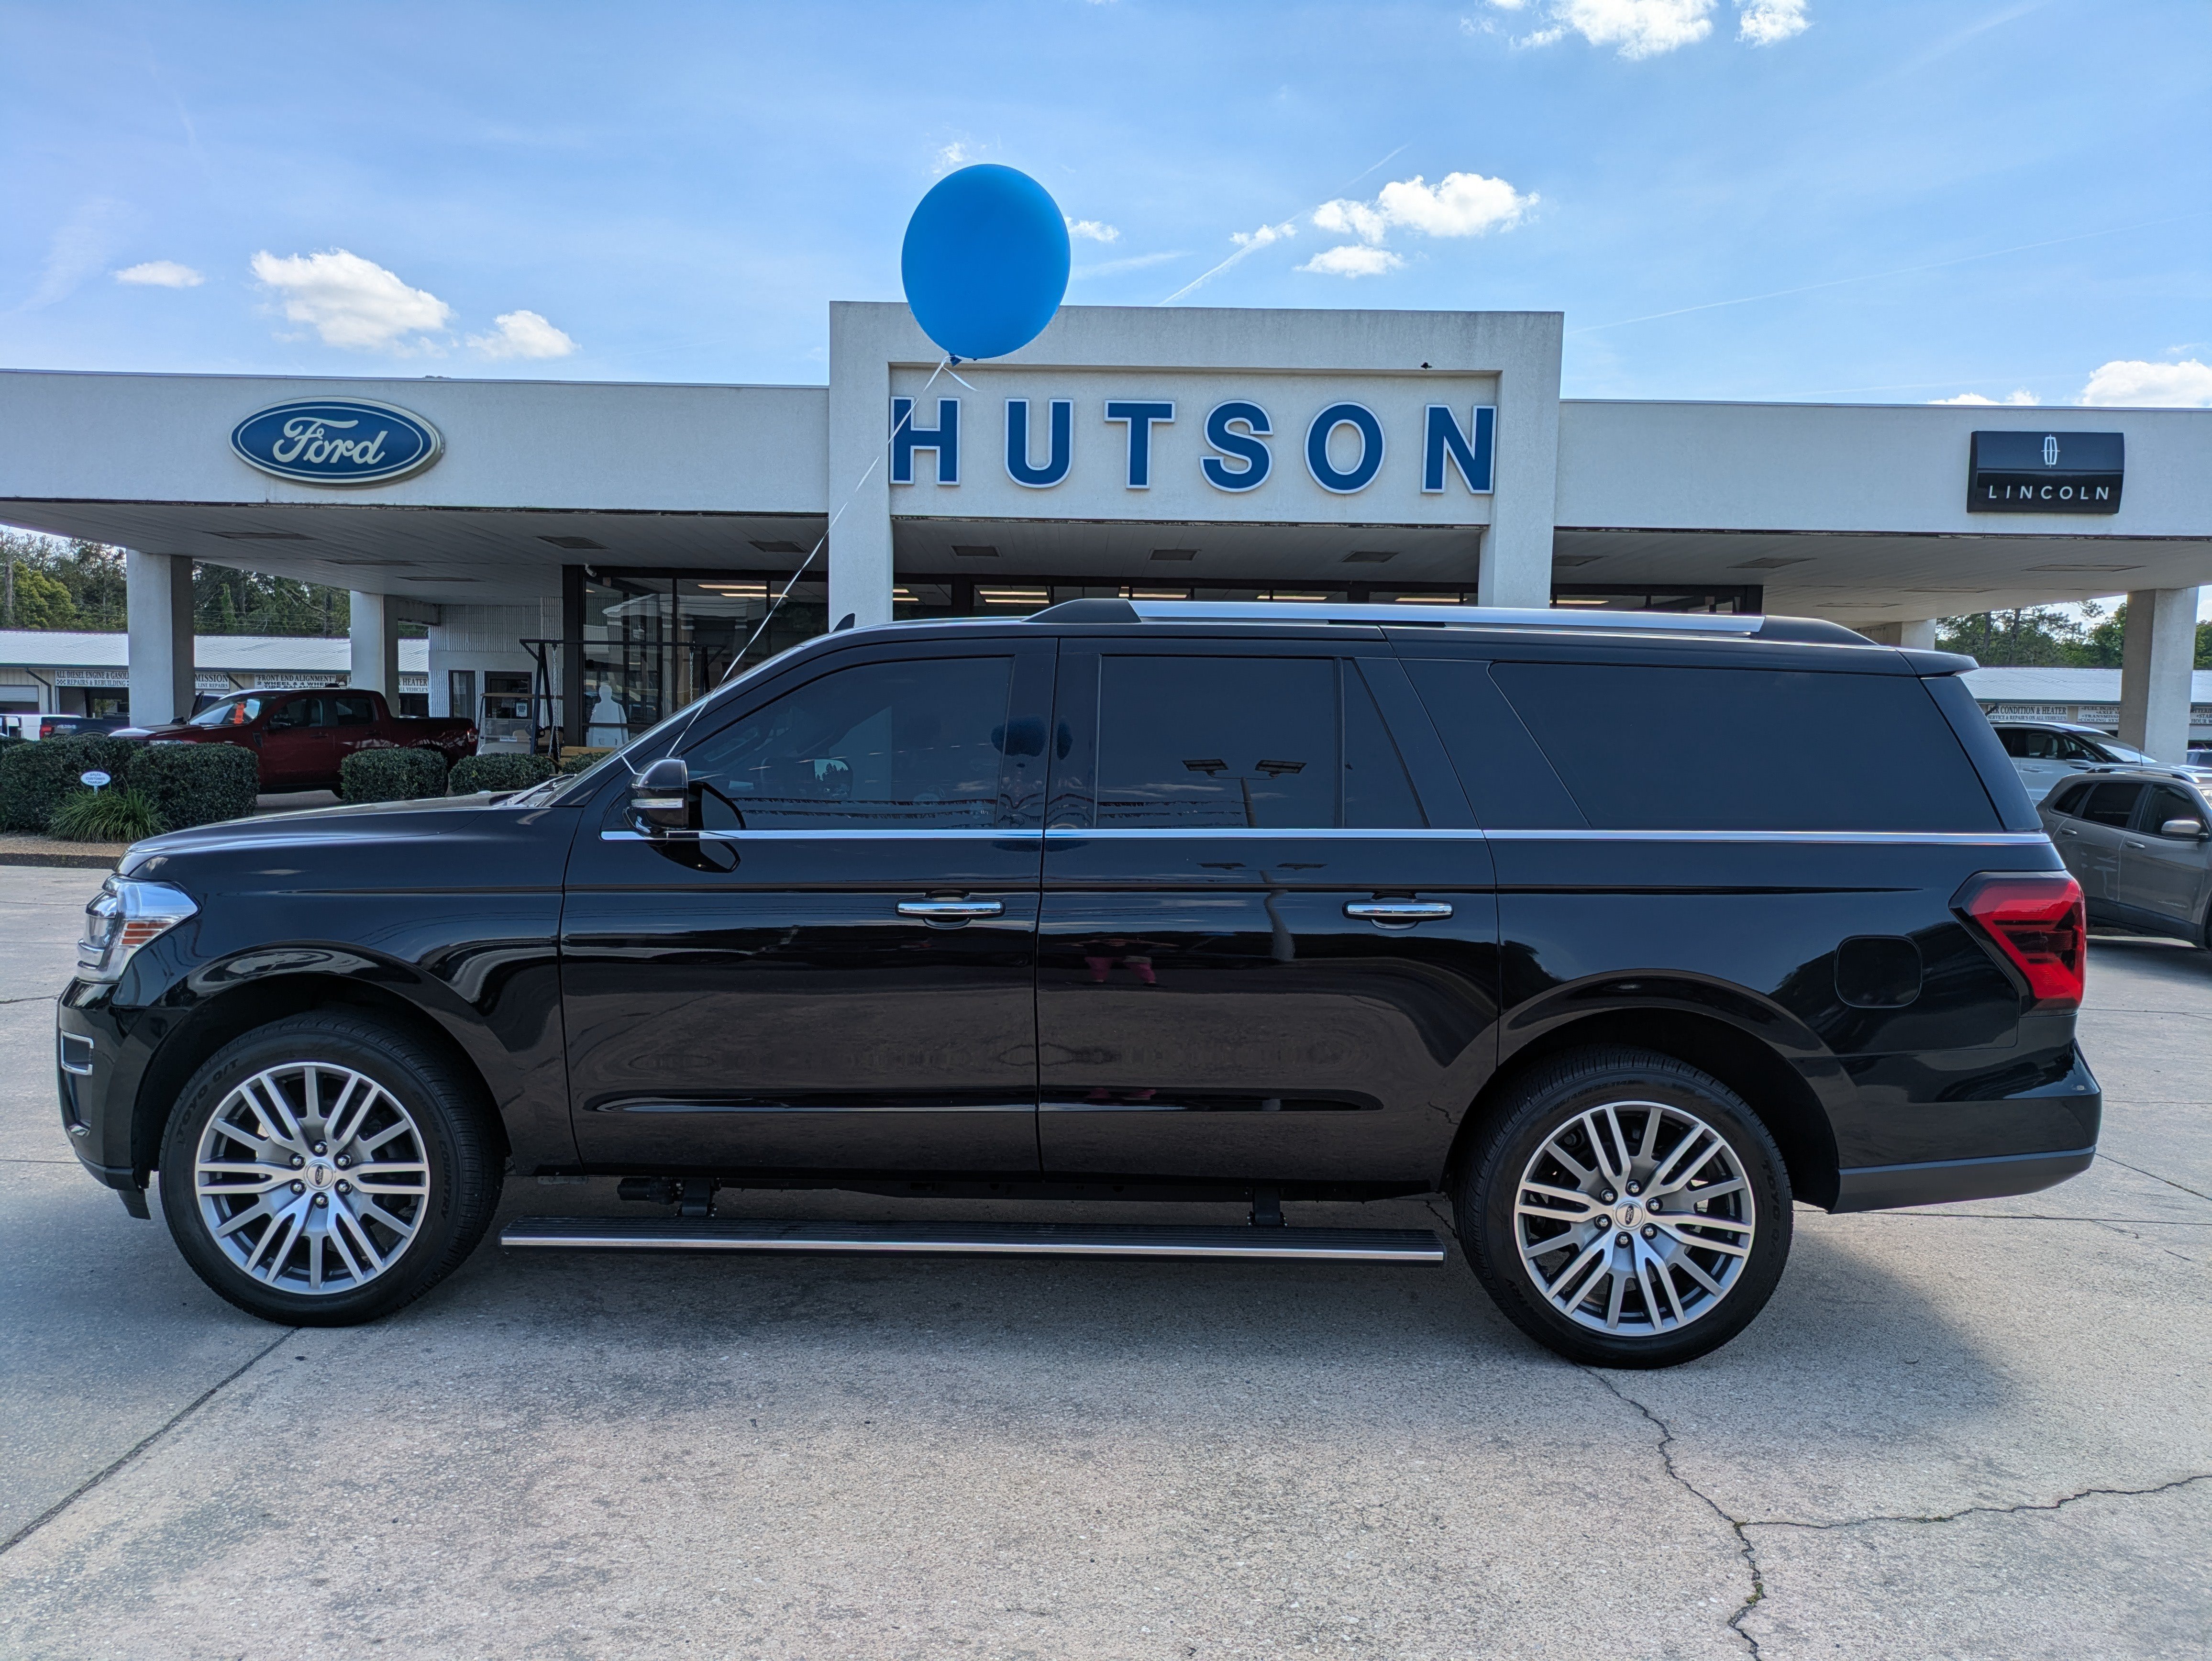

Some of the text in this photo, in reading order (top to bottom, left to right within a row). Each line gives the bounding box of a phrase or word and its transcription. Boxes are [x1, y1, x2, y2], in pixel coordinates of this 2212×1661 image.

[273, 417, 388, 465] Ford
[890, 396, 1498, 495] HUTSON
[1989, 485, 2109, 499] LINCOLN
[402, 678, 427, 686] HEATER
[2001, 706, 2035, 714] CONDITION
[2036, 707, 2040, 715] &
[2042, 707, 2067, 715] HEATER
[177, 1085, 208, 1137] TOYO
